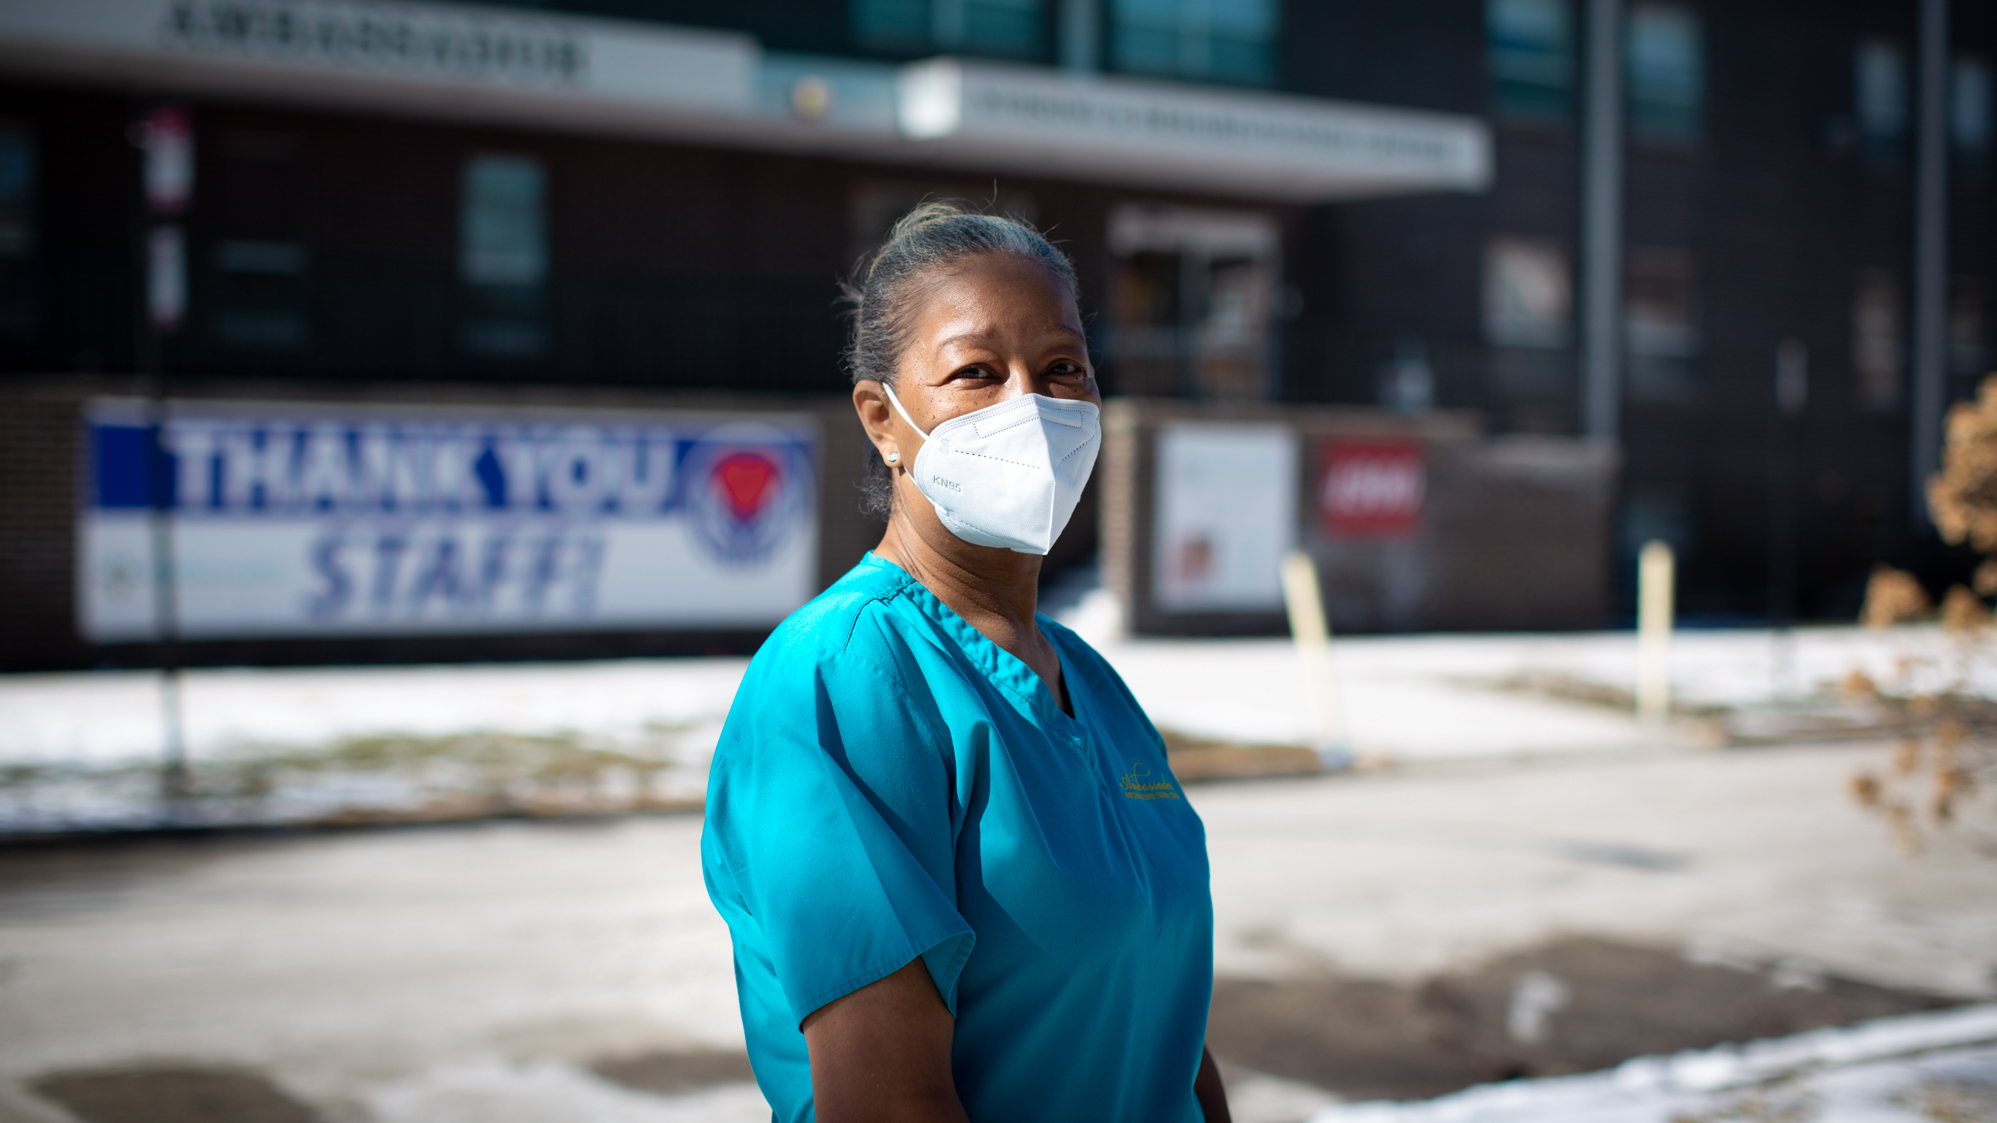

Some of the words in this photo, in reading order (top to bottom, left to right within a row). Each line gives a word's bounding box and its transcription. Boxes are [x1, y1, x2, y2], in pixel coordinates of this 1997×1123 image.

[170, 418, 496, 518] THANK
[482, 423, 671, 520] YOU
[932, 475, 961, 492] KN95
[303, 529, 609, 618] STAFF!
